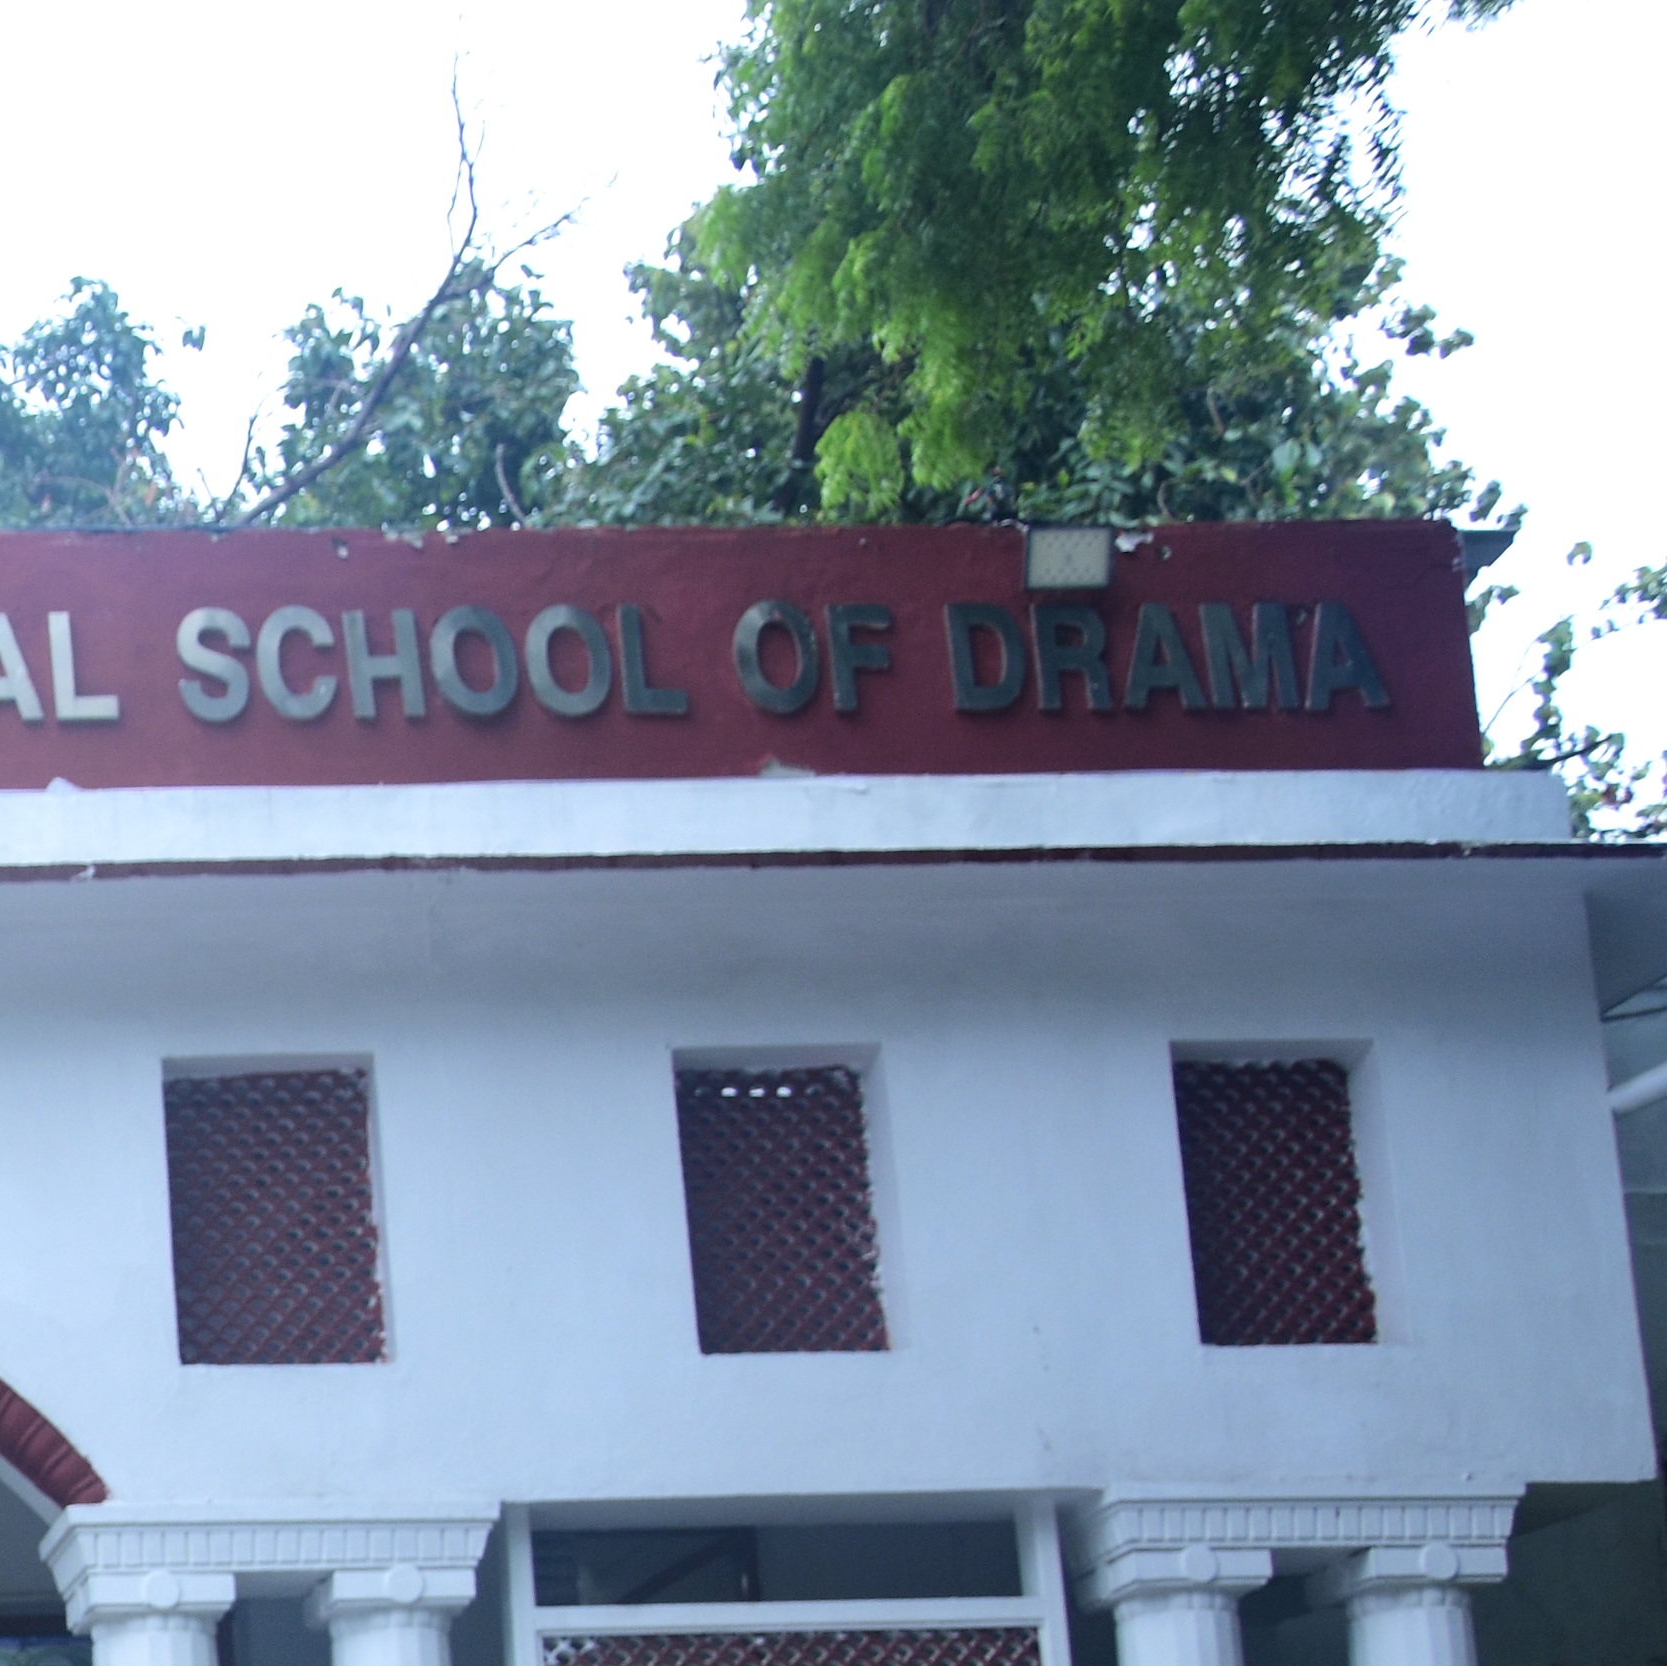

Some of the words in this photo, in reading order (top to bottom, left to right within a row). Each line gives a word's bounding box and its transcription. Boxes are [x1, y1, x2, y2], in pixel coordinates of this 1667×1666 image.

[175, 603, 690, 723] SCHOOL
[732, 600, 893, 716] OF
[943, 601, 1390, 713] DRAMA
